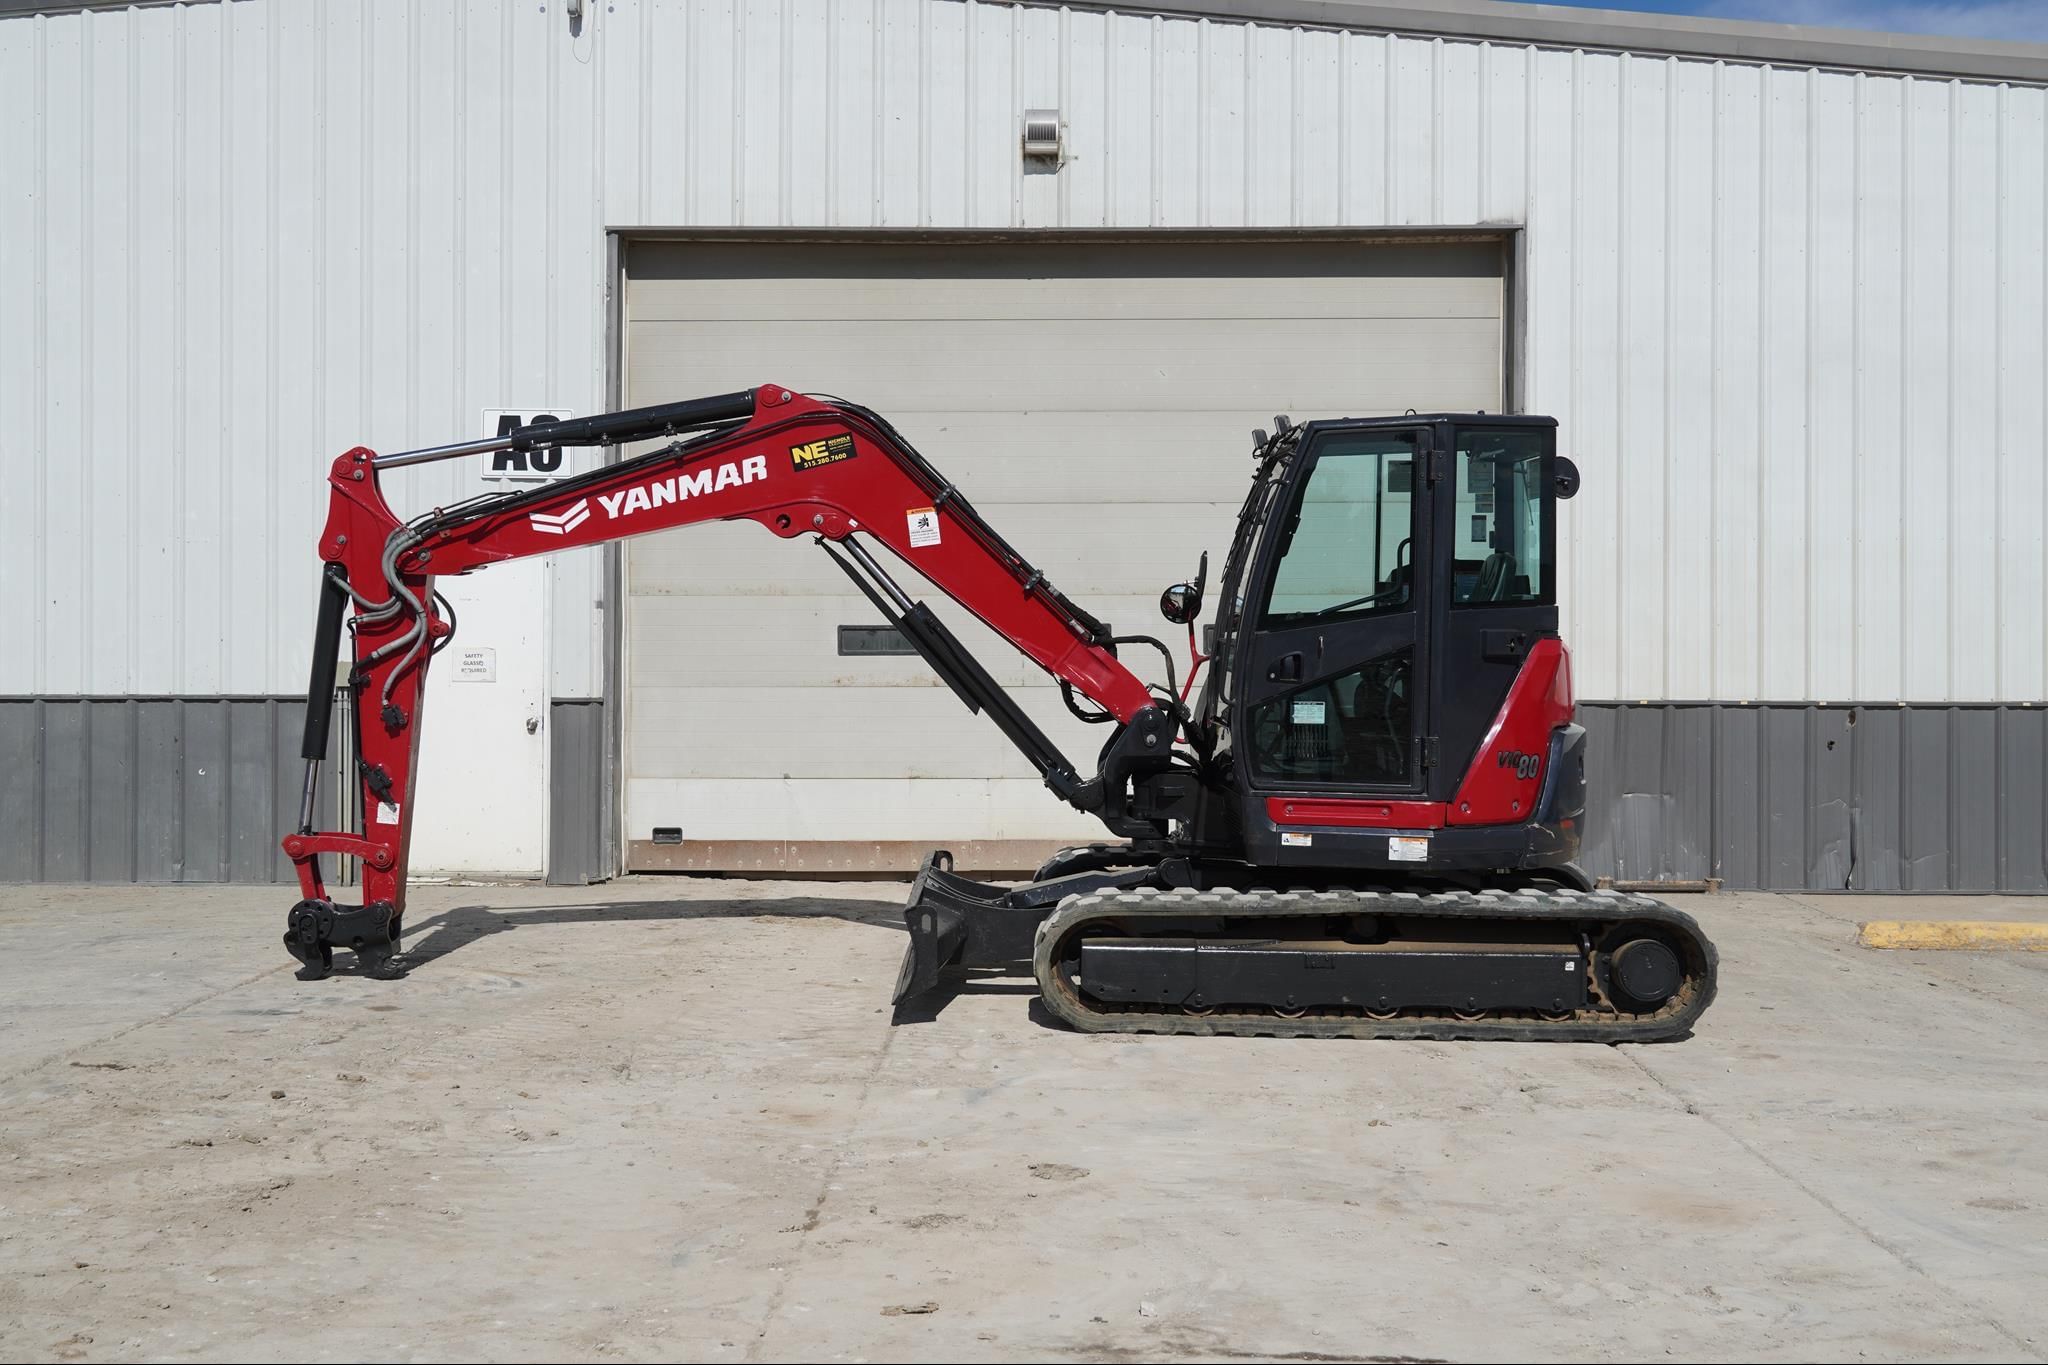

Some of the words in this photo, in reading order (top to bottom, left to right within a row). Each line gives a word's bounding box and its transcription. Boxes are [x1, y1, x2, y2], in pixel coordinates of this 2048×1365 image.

[791, 440, 829, 464] NE
[803, 453, 847, 468] 515.280.7600
[596, 455, 768, 520] YANMAR
